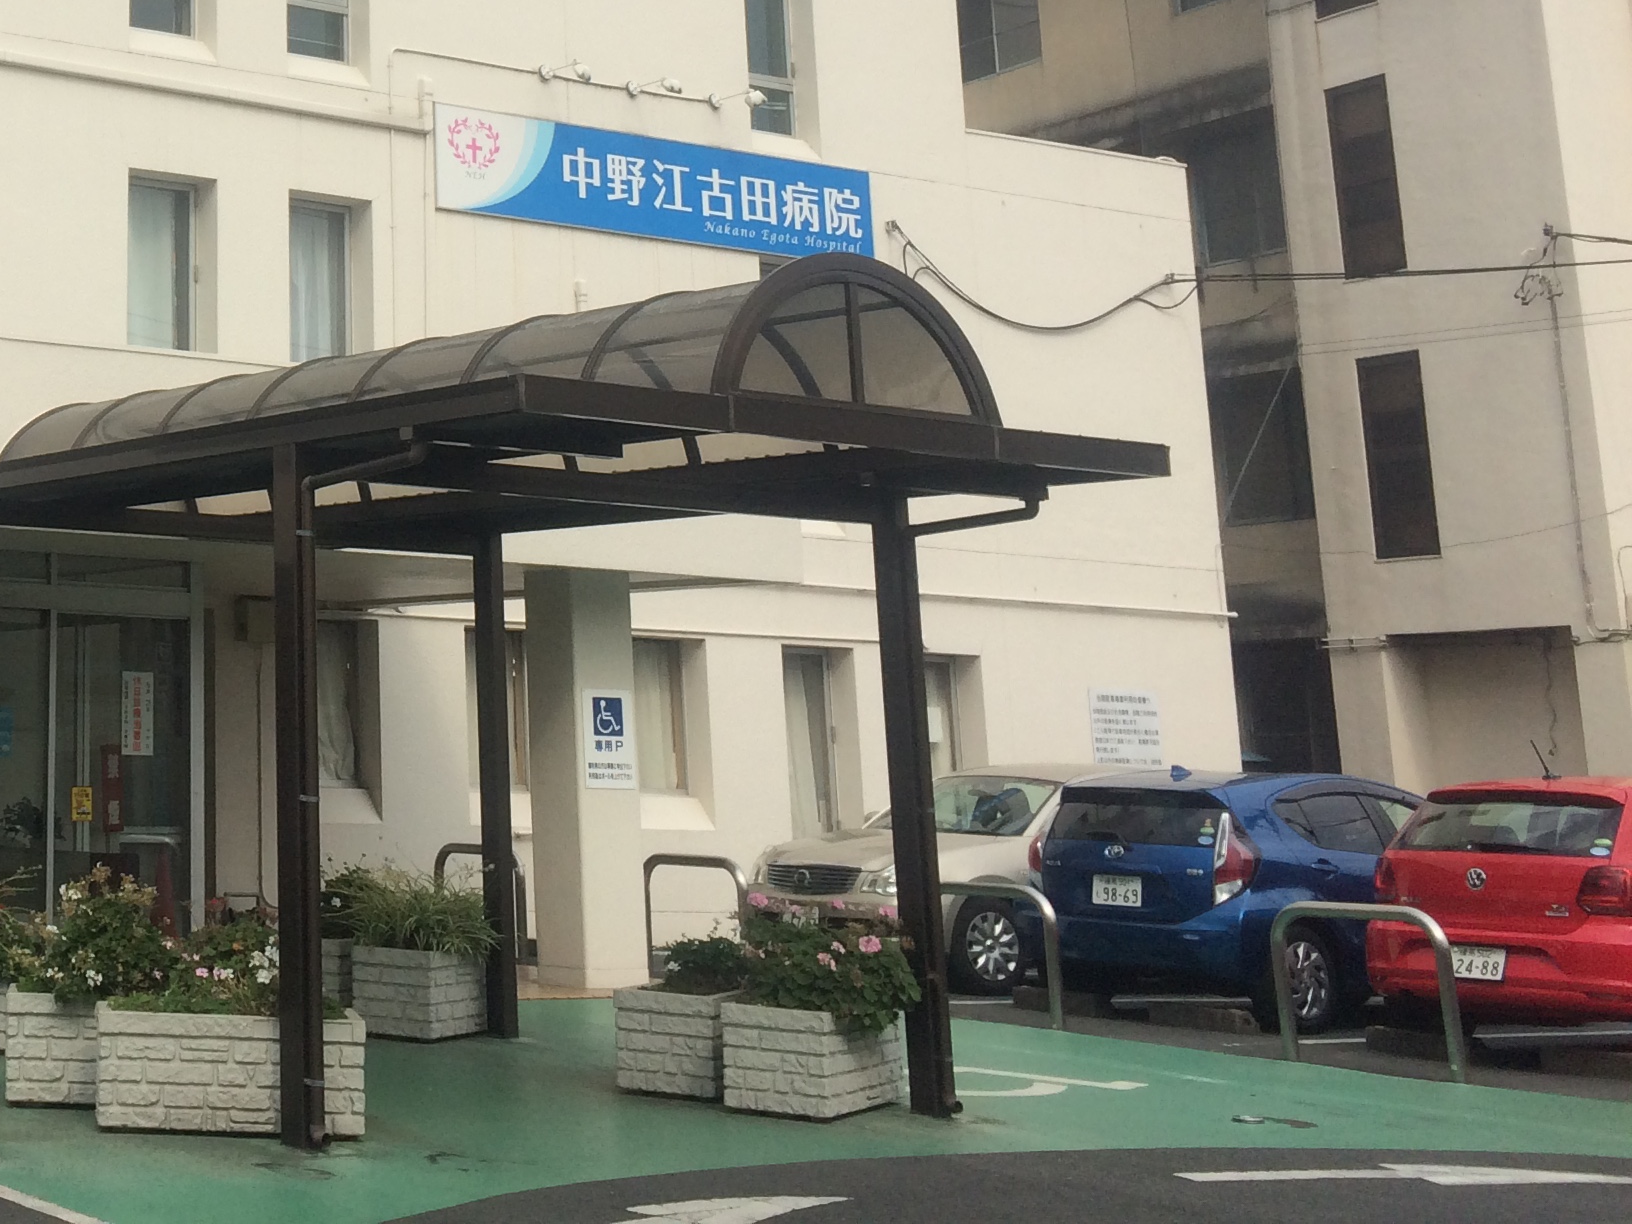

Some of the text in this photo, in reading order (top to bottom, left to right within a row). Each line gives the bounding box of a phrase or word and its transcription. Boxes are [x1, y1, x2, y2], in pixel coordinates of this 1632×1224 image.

[561, 147, 863, 238] 中野江古田病院
[703, 221, 863, 253] Nakano Egota Hospital
[1102, 887, 1139, 904] 98-69
[1454, 958, 1500, 977] 24-88
